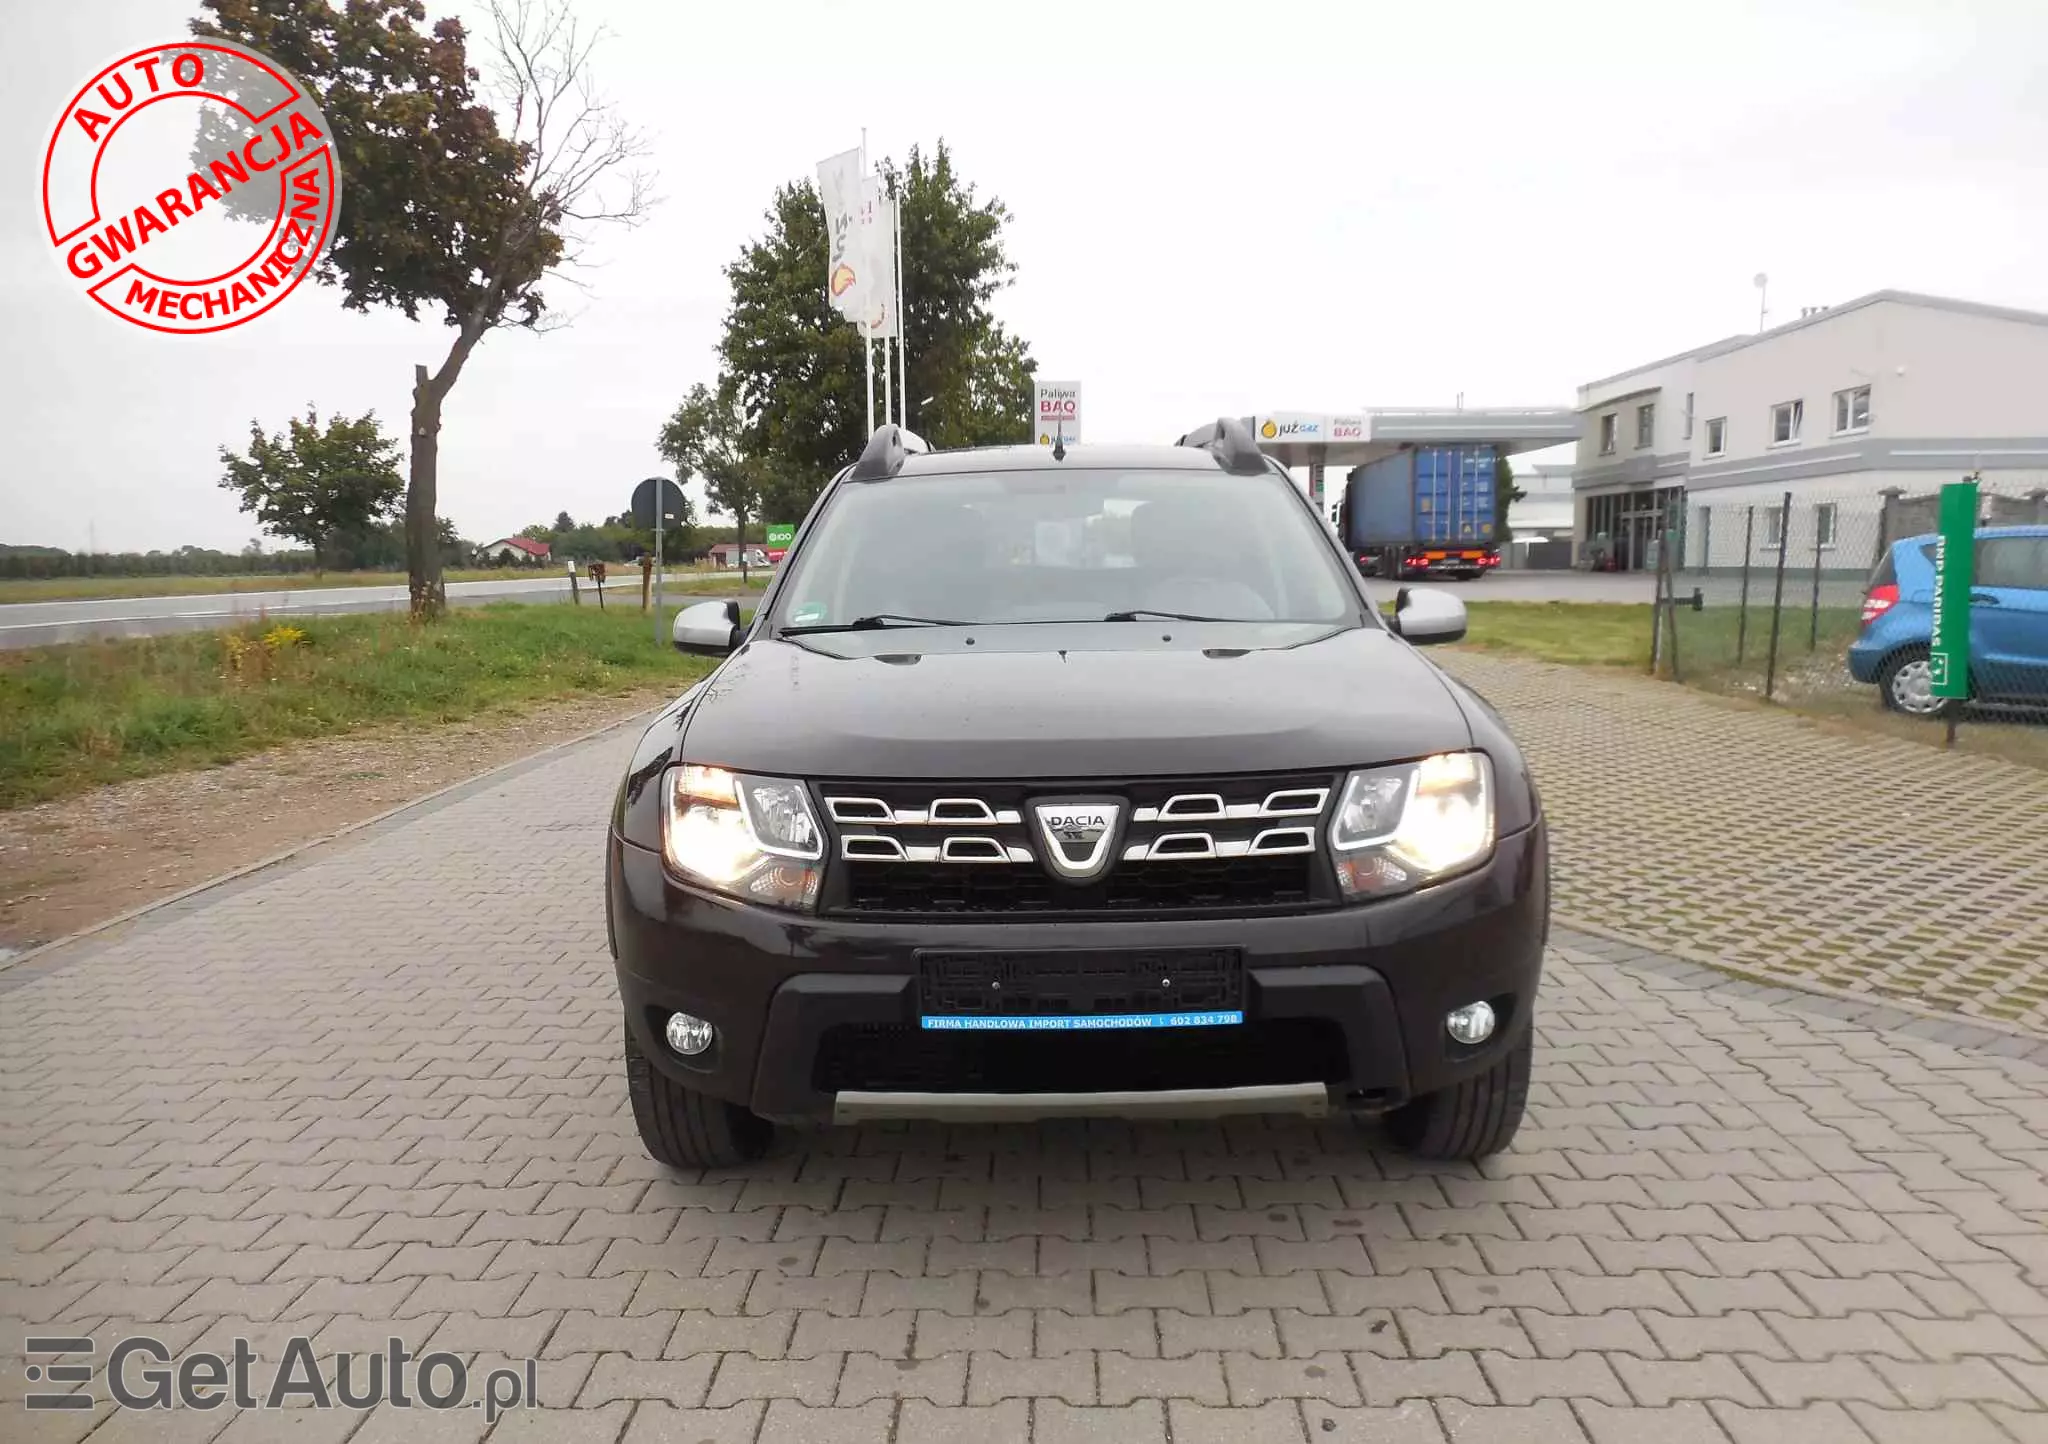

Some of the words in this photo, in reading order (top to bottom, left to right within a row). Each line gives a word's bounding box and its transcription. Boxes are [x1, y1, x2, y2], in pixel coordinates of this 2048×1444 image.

[1040, 388, 1076, 399] Paliwa
[1040, 400, 1076, 413] BAQ
[1050, 815, 1105, 826] DACIA
[928, 1018, 961, 1029] FIRMA
[964, 1018, 1026, 1029] HANDLOWA
[1029, 1018, 1070, 1029] IMPORT
[1072, 1015, 1152, 1028] SAMOCHODÓW
[1170, 1015, 1190, 1026] 602
[1193, 1015, 1214, 1025] 834
